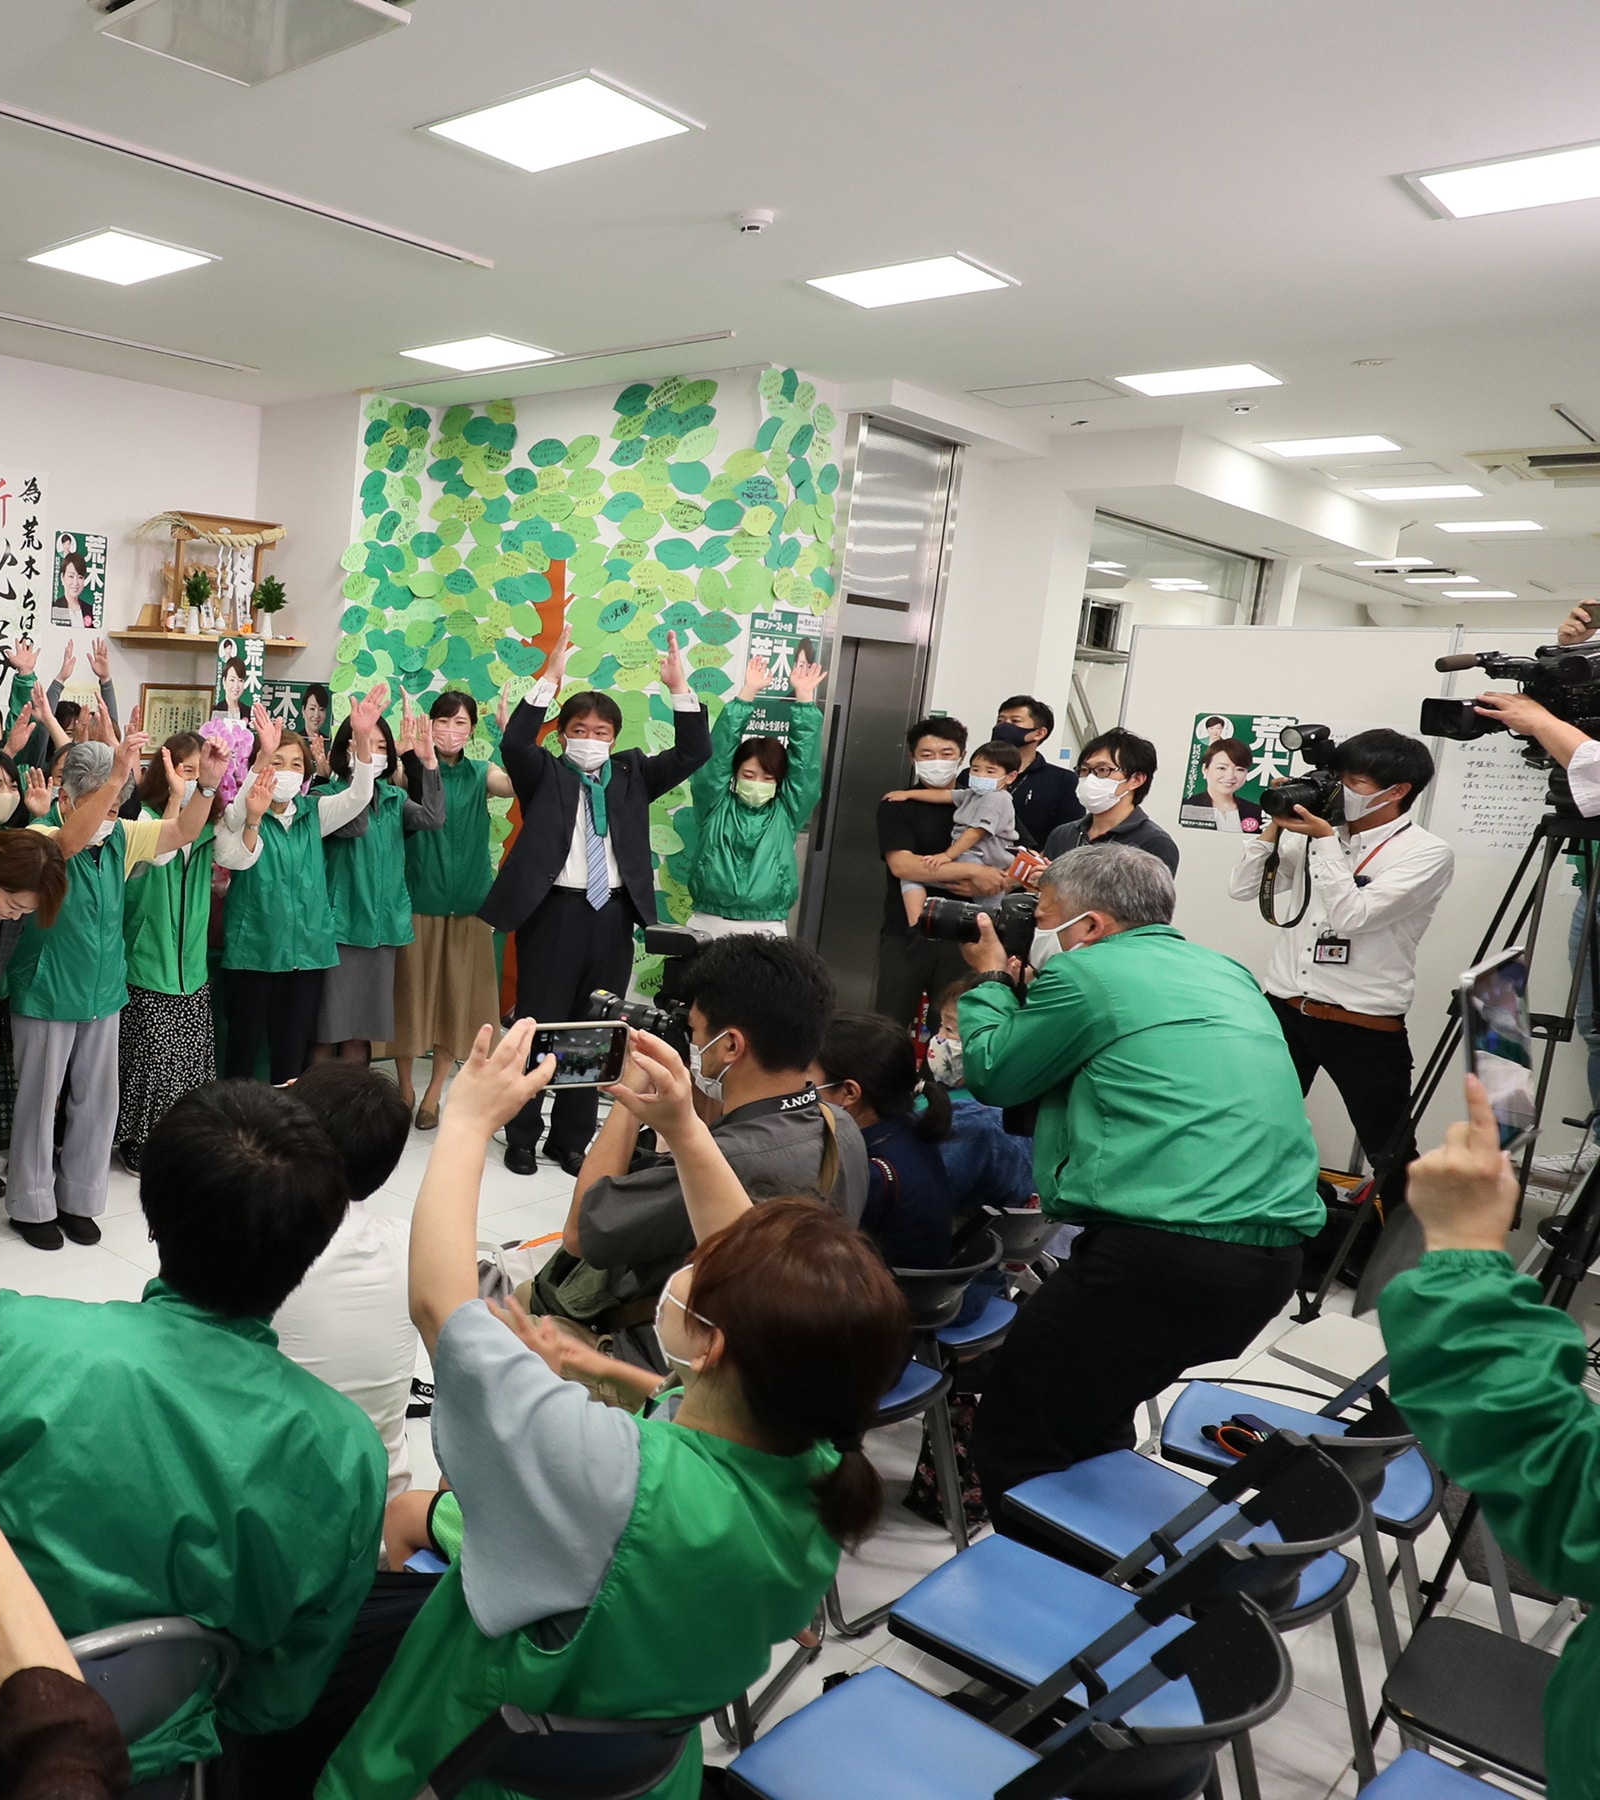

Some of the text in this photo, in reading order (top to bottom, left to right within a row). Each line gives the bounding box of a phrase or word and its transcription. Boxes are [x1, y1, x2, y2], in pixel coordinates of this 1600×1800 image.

[85, 535, 106, 591] 荒木
[92, 591, 103, 628] ちはる
[244, 639, 264, 693] 荒木
[1247, 717, 1296, 786] 荒木
[1245, 820, 1256, 828] 39
[780, 1090, 816, 1110] SONY
